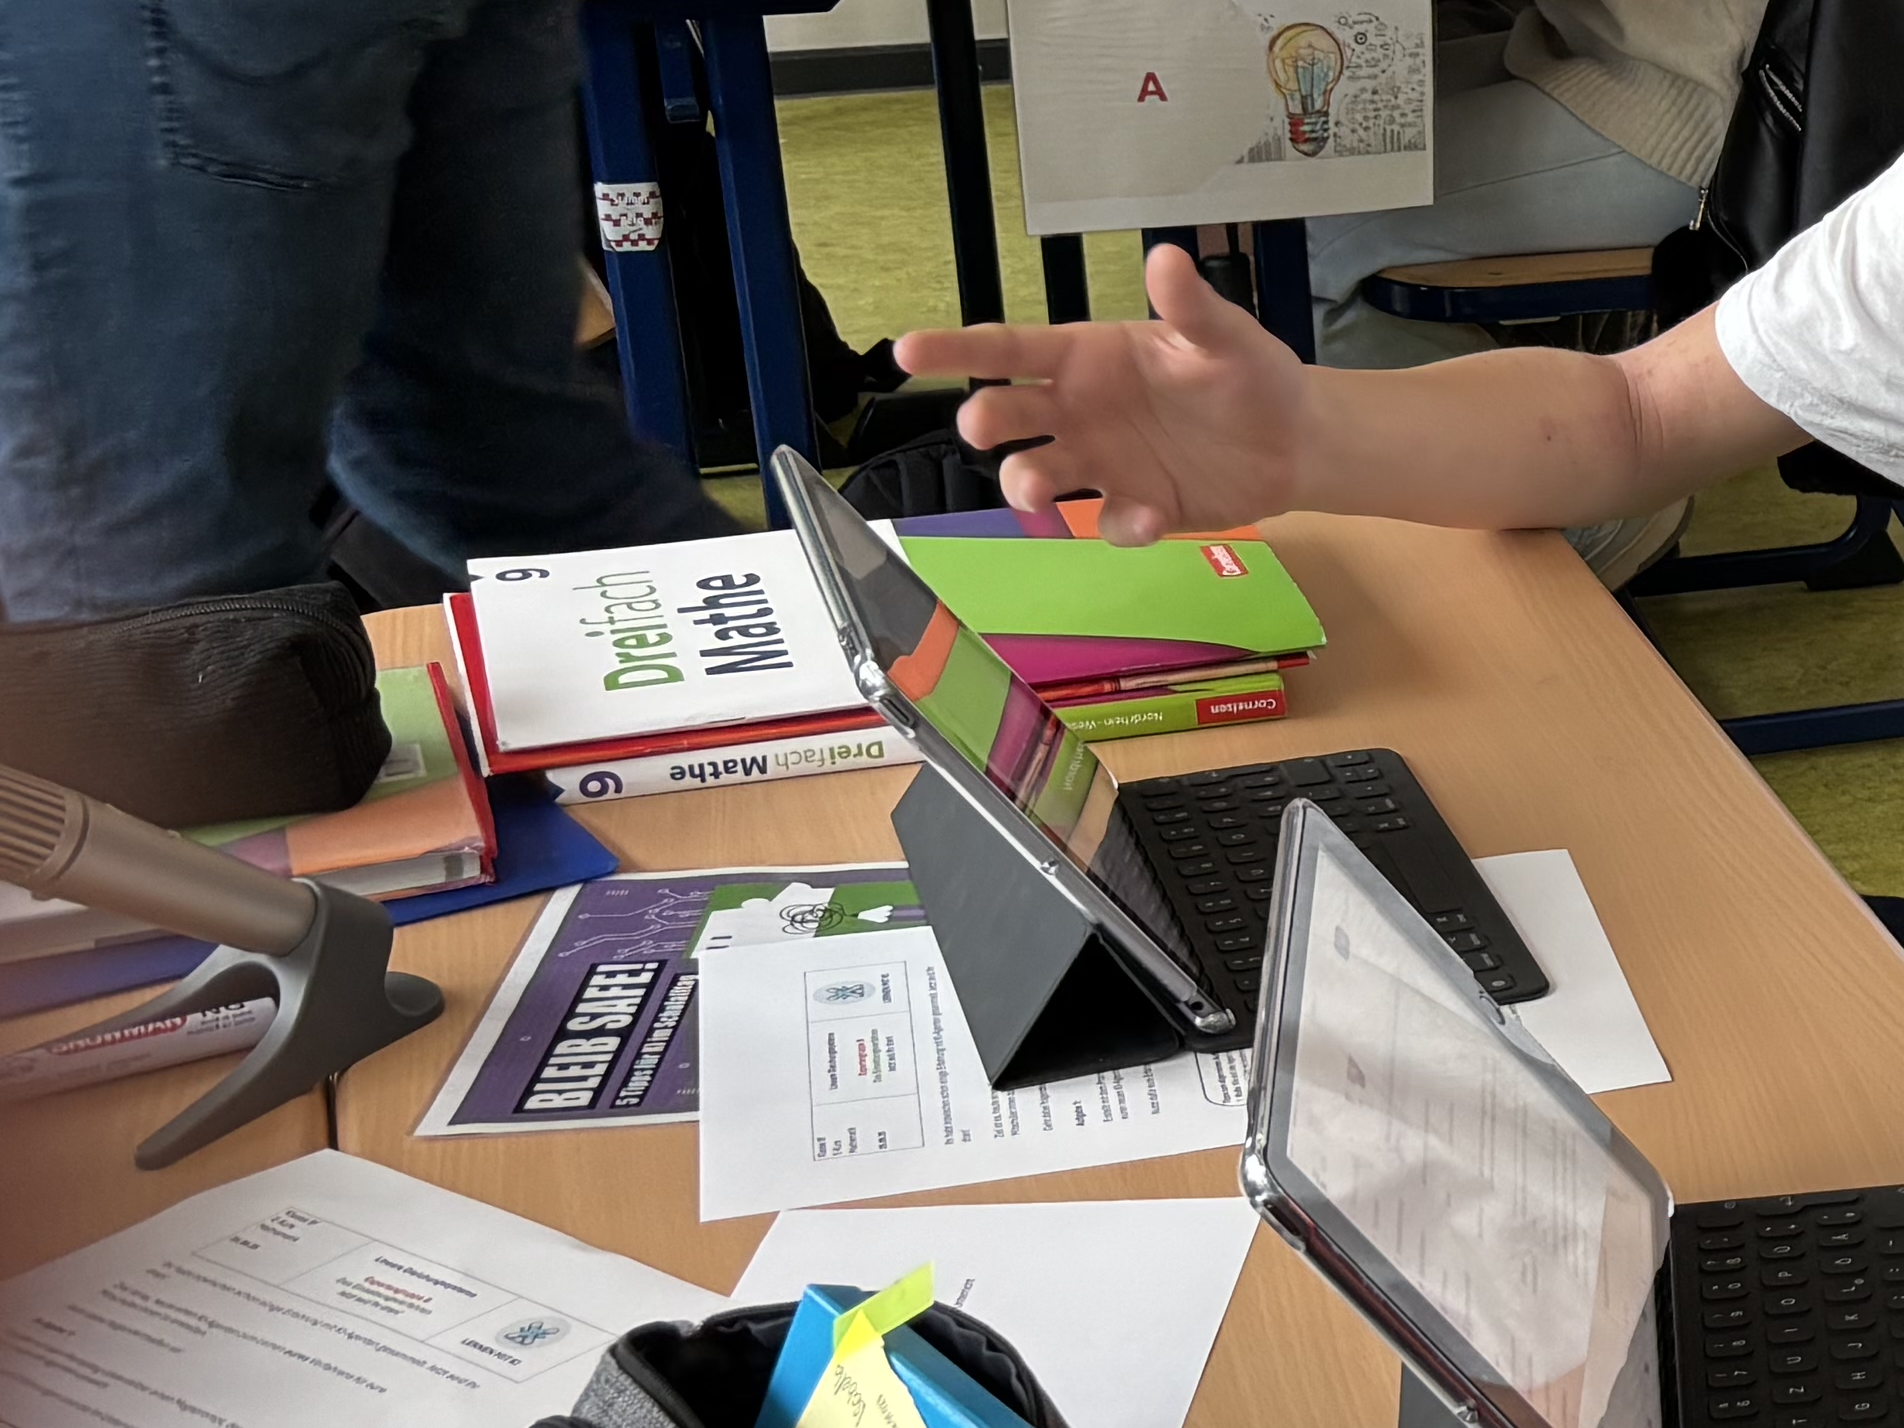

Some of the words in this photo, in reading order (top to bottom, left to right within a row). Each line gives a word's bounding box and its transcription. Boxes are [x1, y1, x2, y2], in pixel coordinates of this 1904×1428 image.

[1137, 72, 1168, 102] A
[573, 570, 685, 692] Dreifach
[677, 572, 794, 676] Mathe
[1210, 697, 1276, 715] Cornelsen
[669, 755, 767, 782] Mathe
[773, 740, 884, 771] Dreifach
[567, 962, 659, 1031] SAFE!
[523, 1036, 621, 1110] BLEIB
